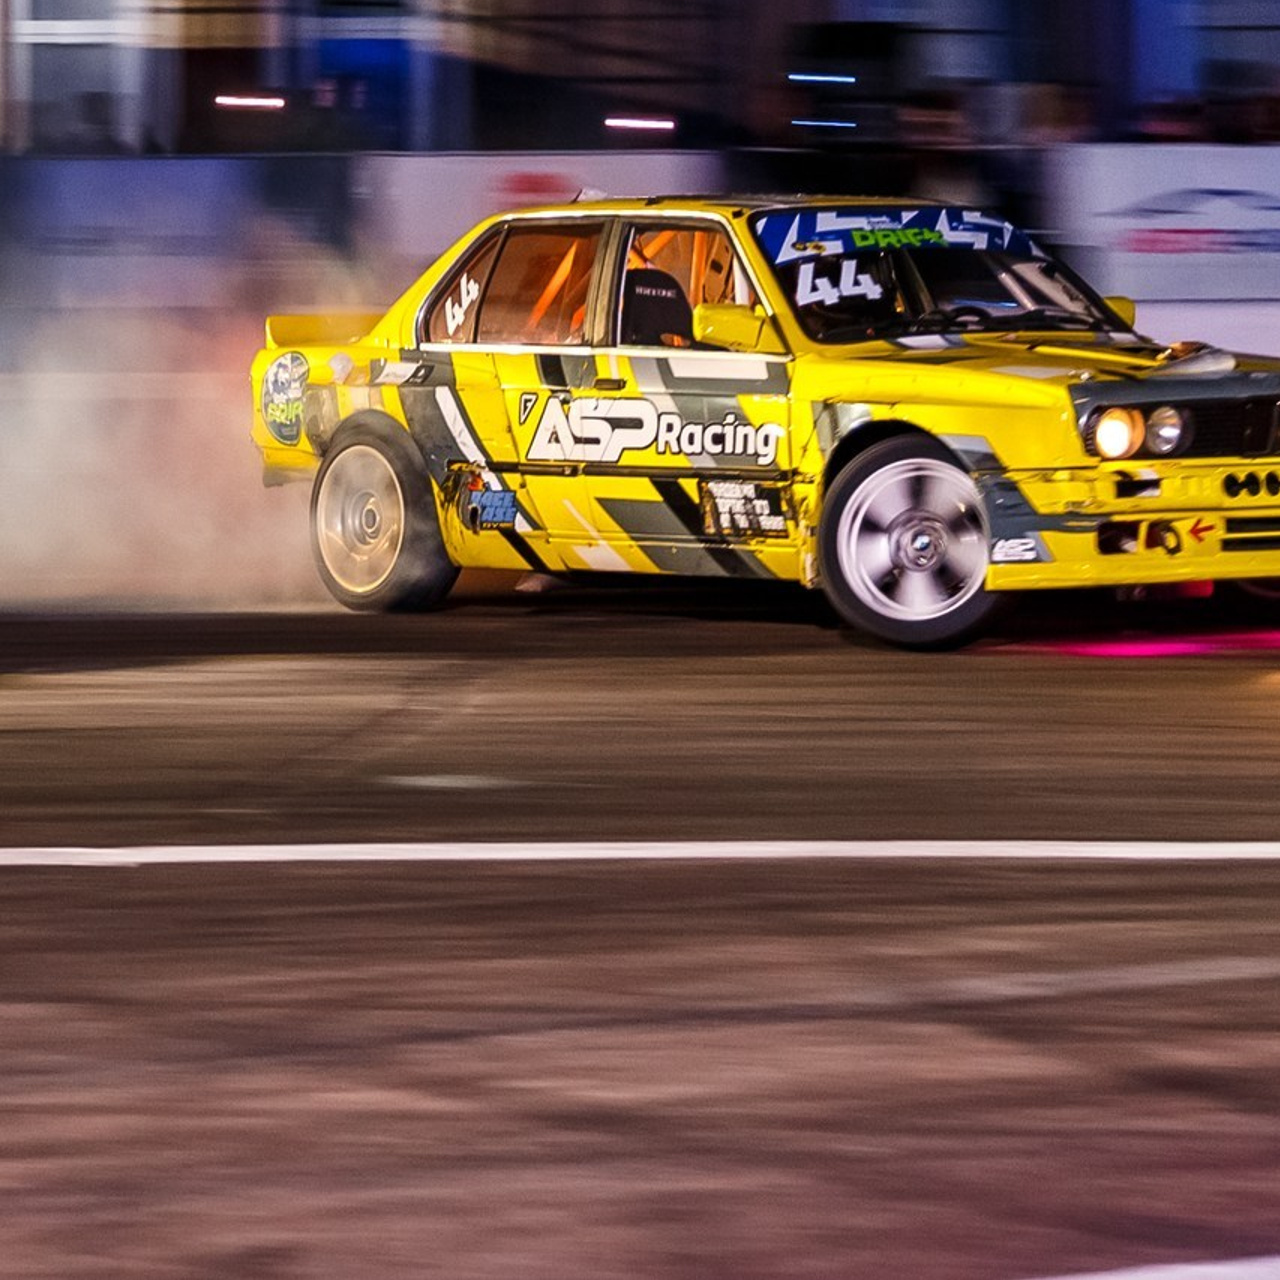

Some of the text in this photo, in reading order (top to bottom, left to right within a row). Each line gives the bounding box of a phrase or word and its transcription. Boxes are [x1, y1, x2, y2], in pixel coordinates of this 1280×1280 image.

[444, 273, 479, 336] 44
[797, 259, 883, 306] 44
[525, 396, 779, 466] ASP Racing
